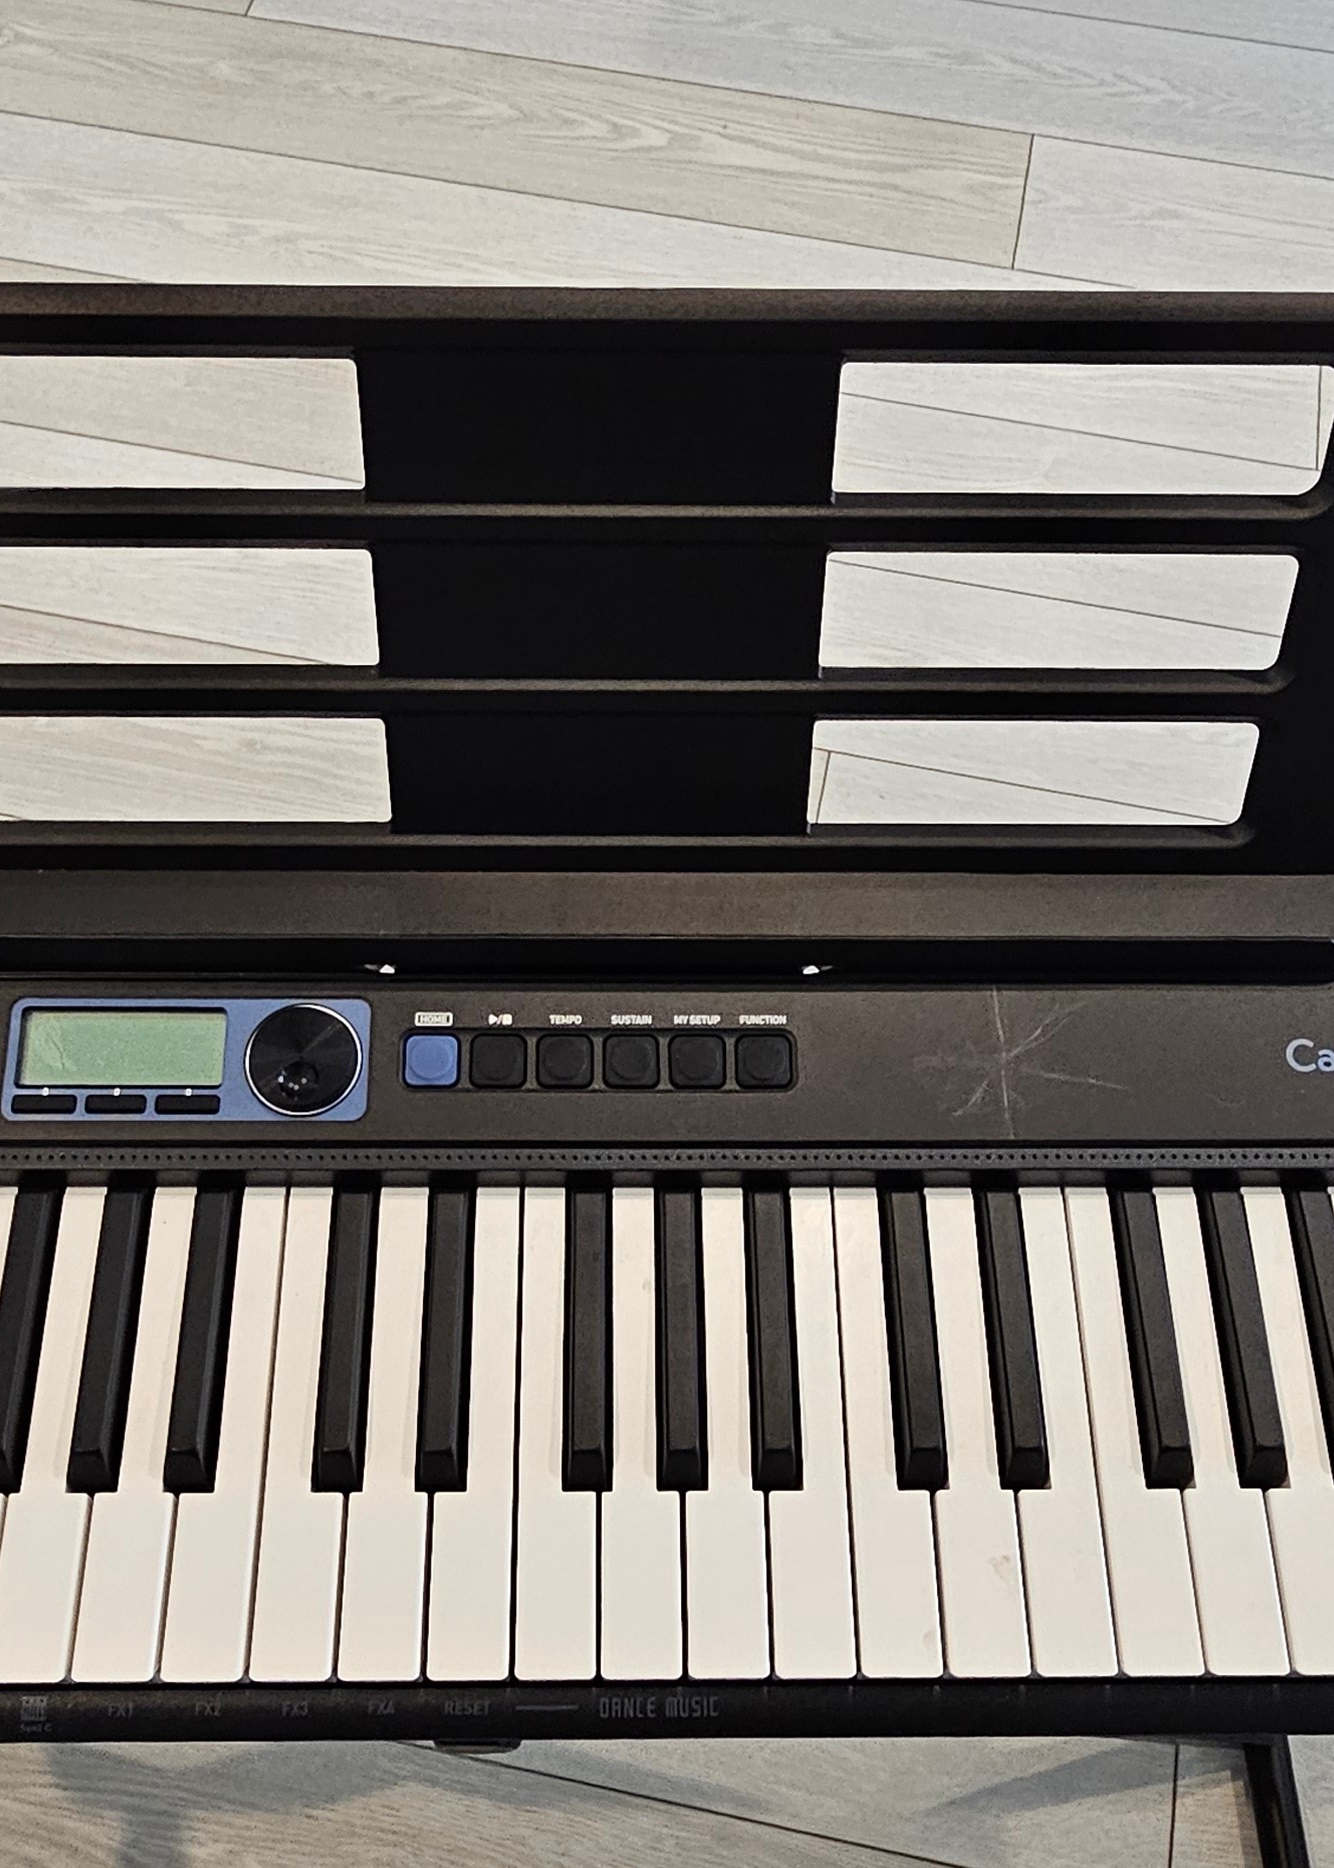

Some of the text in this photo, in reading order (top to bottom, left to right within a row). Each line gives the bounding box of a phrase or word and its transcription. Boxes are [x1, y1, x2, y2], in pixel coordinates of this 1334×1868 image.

[420, 1014, 448, 1025] HOME
[549, 1014, 583, 1026] TEMPO
[610, 1014, 653, 1026] SUSTAIN
[673, 1014, 721, 1026] MY SETUP
[738, 1014, 787, 1026] FUNCTION
[108, 1704, 133, 1718] FX1
[195, 1703, 221, 1717] FX2
[282, 1703, 308, 1717] FX3
[368, 1702, 395, 1716] FX4
[445, 1701, 491, 1716] RESET
[599, 1696, 719, 1718] DANCE MUSIC
